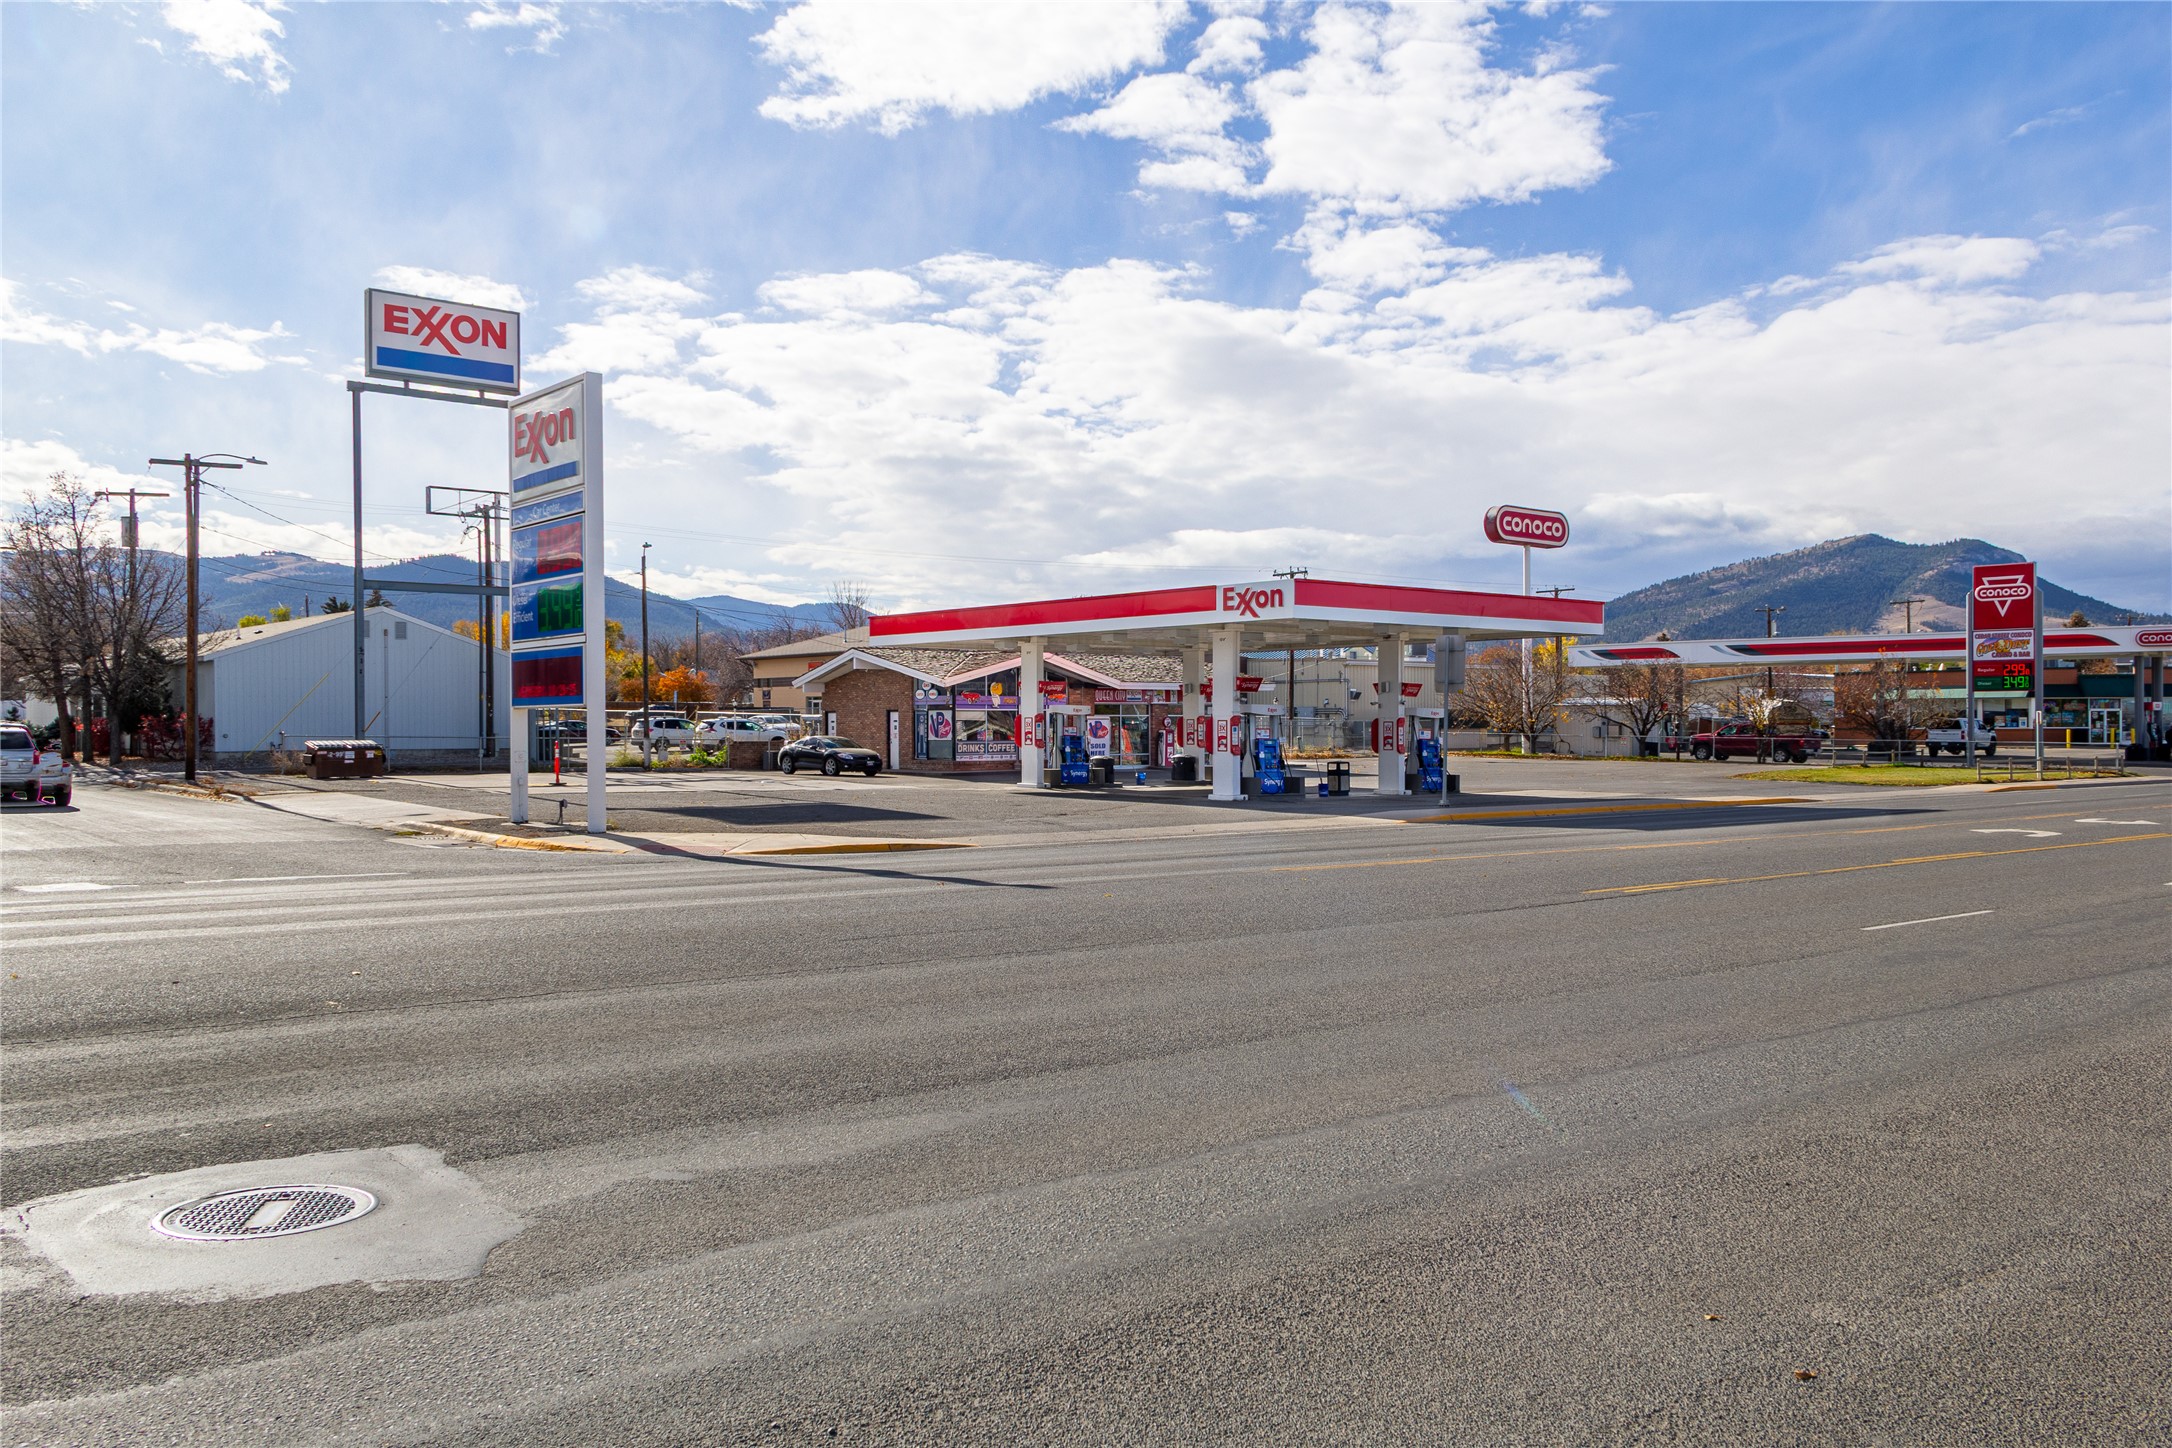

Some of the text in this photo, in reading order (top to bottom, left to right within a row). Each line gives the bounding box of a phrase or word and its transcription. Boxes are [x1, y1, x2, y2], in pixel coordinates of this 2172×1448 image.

[383, 303, 507, 356] EXXON
[514, 406, 575, 464] Exxon
[1223, 586, 1284, 618] Exxon
[1095, 690, 1125, 701] QUEEN CITY
[957, 744, 1016, 753] DRINKS COFFEE
[1070, 769, 1088, 777] Synergy
